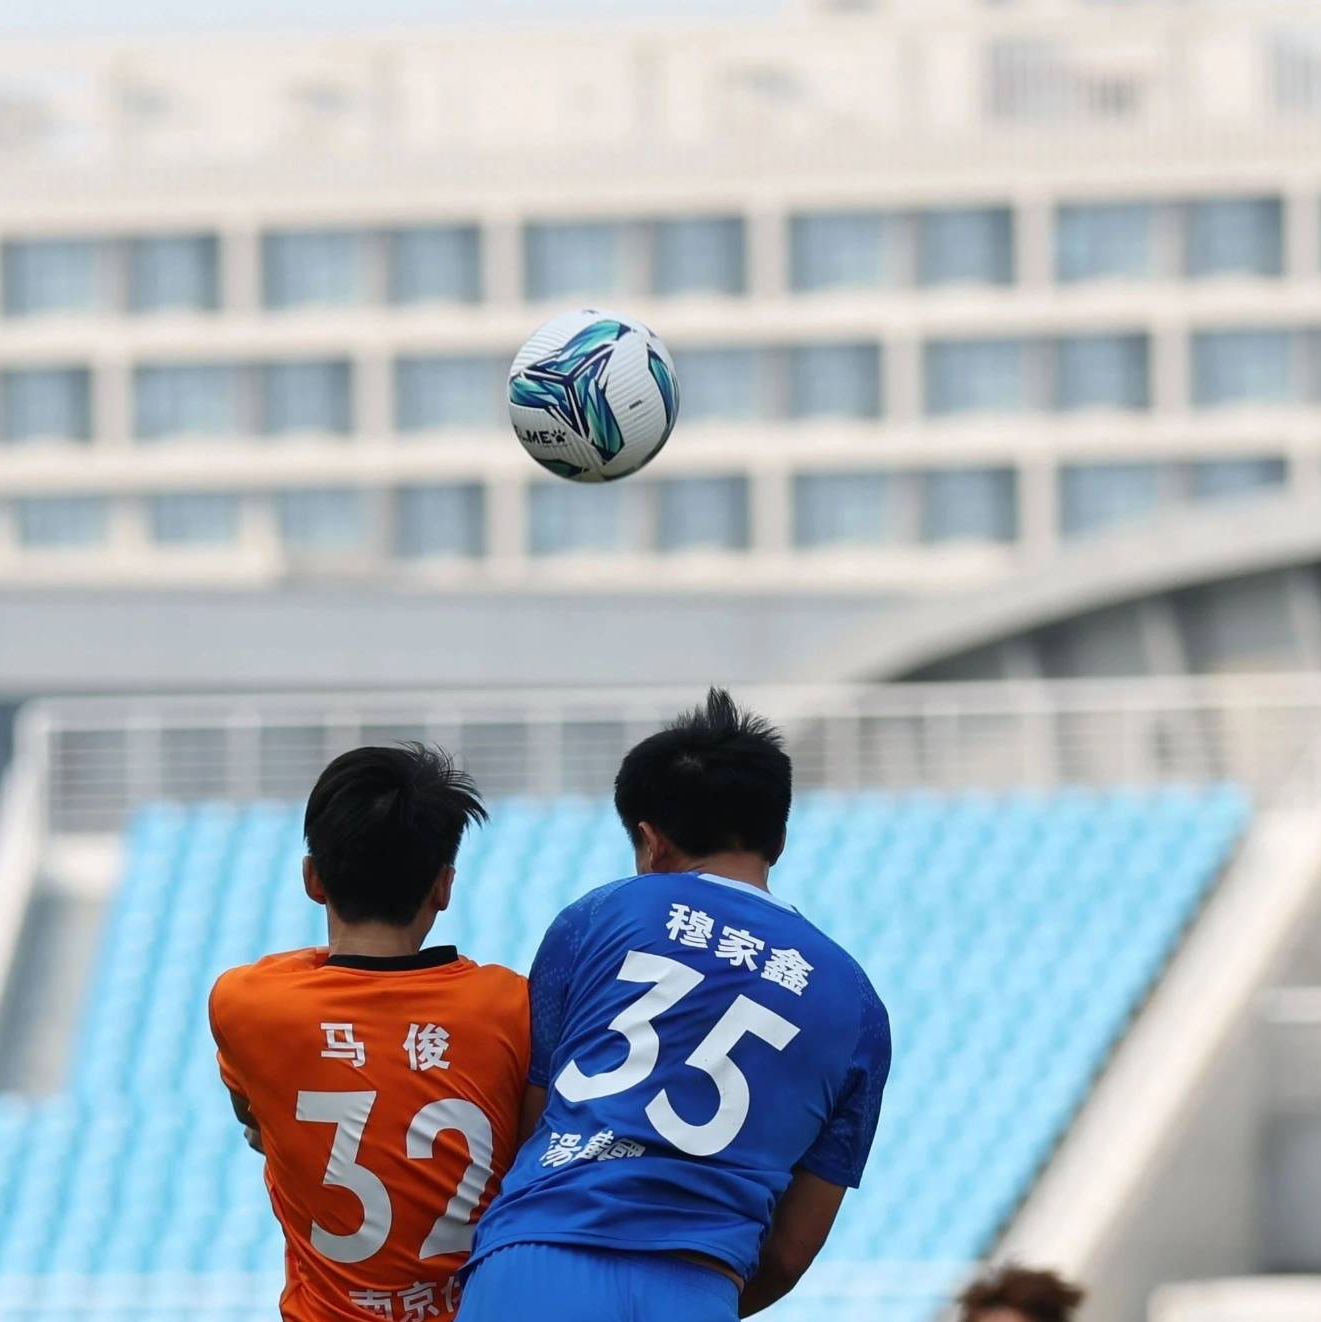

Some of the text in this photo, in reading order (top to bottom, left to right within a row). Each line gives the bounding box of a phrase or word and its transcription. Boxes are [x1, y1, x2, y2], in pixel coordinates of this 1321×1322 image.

[666, 903, 814, 996] 穆家鑫
[320, 1022, 450, 1071] 马俊
[555, 950, 800, 1157] 35
[295, 1089, 494, 1264] 32
